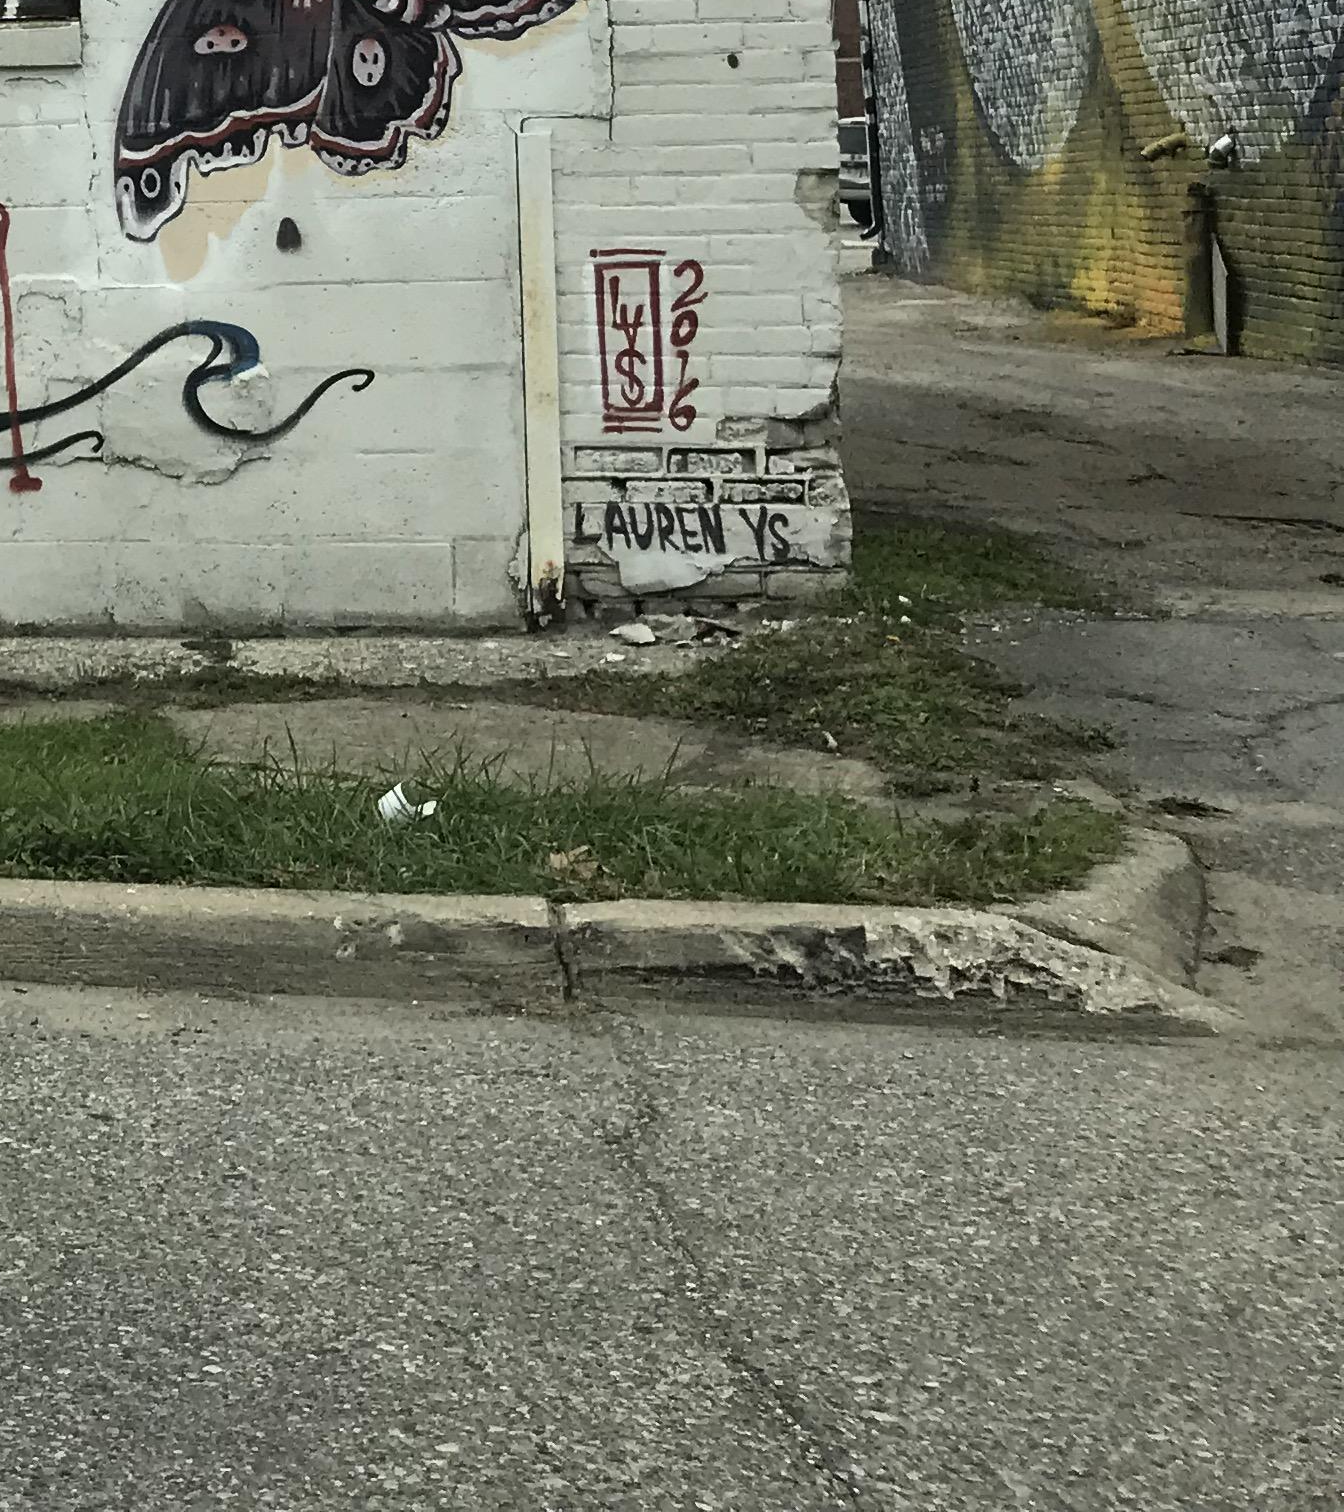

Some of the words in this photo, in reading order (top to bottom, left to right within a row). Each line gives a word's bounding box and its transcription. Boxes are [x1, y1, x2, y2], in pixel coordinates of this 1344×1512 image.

[667, 259, 708, 432] 2016
[574, 500, 726, 554] LAUREN
[739, 504, 791, 561] YS
